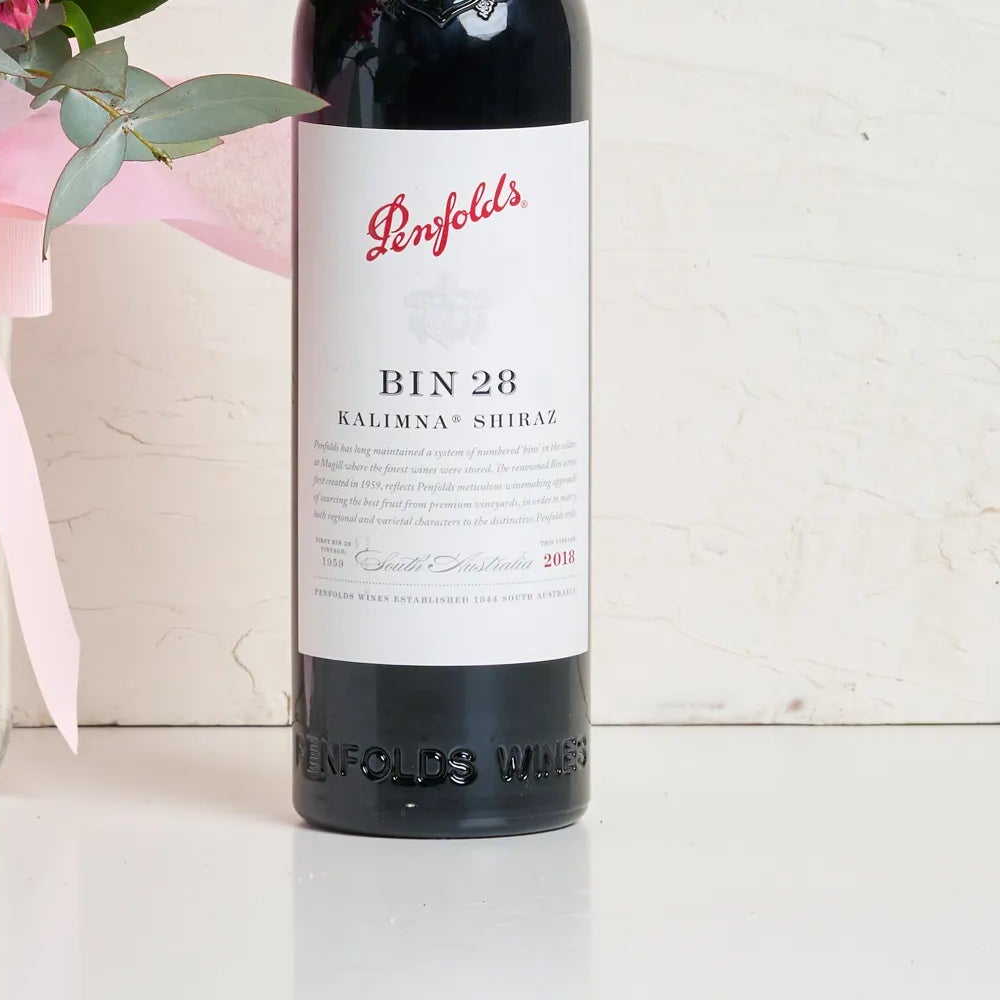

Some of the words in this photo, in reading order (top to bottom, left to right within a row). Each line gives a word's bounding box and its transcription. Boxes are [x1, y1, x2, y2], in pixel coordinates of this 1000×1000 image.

[379, 369, 459, 397] BIN
[471, 368, 517, 396] 28
[473, 409, 557, 429] SHIRAZ
[314, 440, 339, 453] Penfolds
[341, 443, 352, 452] has
[355, 444, 370, 457] long
[373, 447, 424, 456] maintained
[434, 449, 463, 459] system
[466, 447, 478, 459] of
[477, 445, 520, 455] numbered
[550, 442, 561, 451] the
[320, 458, 344, 471] Magill
[344, 461, 368, 471] where
[370, 462, 382, 472] the
[382, 463, 408, 475] finest
[411, 465, 437, 474] wines
[440, 466, 461, 474] were
[465, 464, 492, 474] stored.
[496, 464, 510, 473] The
[511, 460, 549, 472] renowned
[550, 459, 561, 469] Bin
[325, 478, 349, 487] created
[350, 479, 358, 488] in
[361, 480, 383, 490] 1959,
[385, 481, 415, 493] reflects
[417, 482, 455, 494] Penfolds
[457, 482, 502, 492] meticulous
[505, 478, 551, 489] winemaking
[313, 492, 320, 504] of
[321, 495, 348, 507] sourcing
[350, 496, 361, 505] the
[363, 497, 380, 507] best
[380, 498, 402, 509] fruit
[403, 499, 426, 511] from
[429, 500, 472, 512] premium
[475, 498, 520, 511] vineyards,
[522, 497, 531, 505] in
[532, 495, 551, 505] order
[327, 512, 358, 523] regional
[359, 515, 375, 524] and
[376, 517, 412, 526] varietal
[414, 517, 460, 526] characters
[463, 518, 472, 526] to
[474, 517, 488, 526] the
[490, 516, 534, 525] distinctive
[536, 511, 563, 524] Penfolds
[322, 557, 344, 568] 1959
[355, 548, 430, 571] South
[428, 551, 533, 572] Australia
[543, 549, 575, 568] 2018
[314, 588, 354, 599] PENFOLDS
[358, 593, 390, 602] WINES
[393, 595, 469, 604] ESTABLISHED
[475, 595, 498, 603] 1844
[502, 592, 533, 602] SOUTH
[537, 587, 576, 600] AUSTRALIA
[496, 734, 587, 783] WINES
